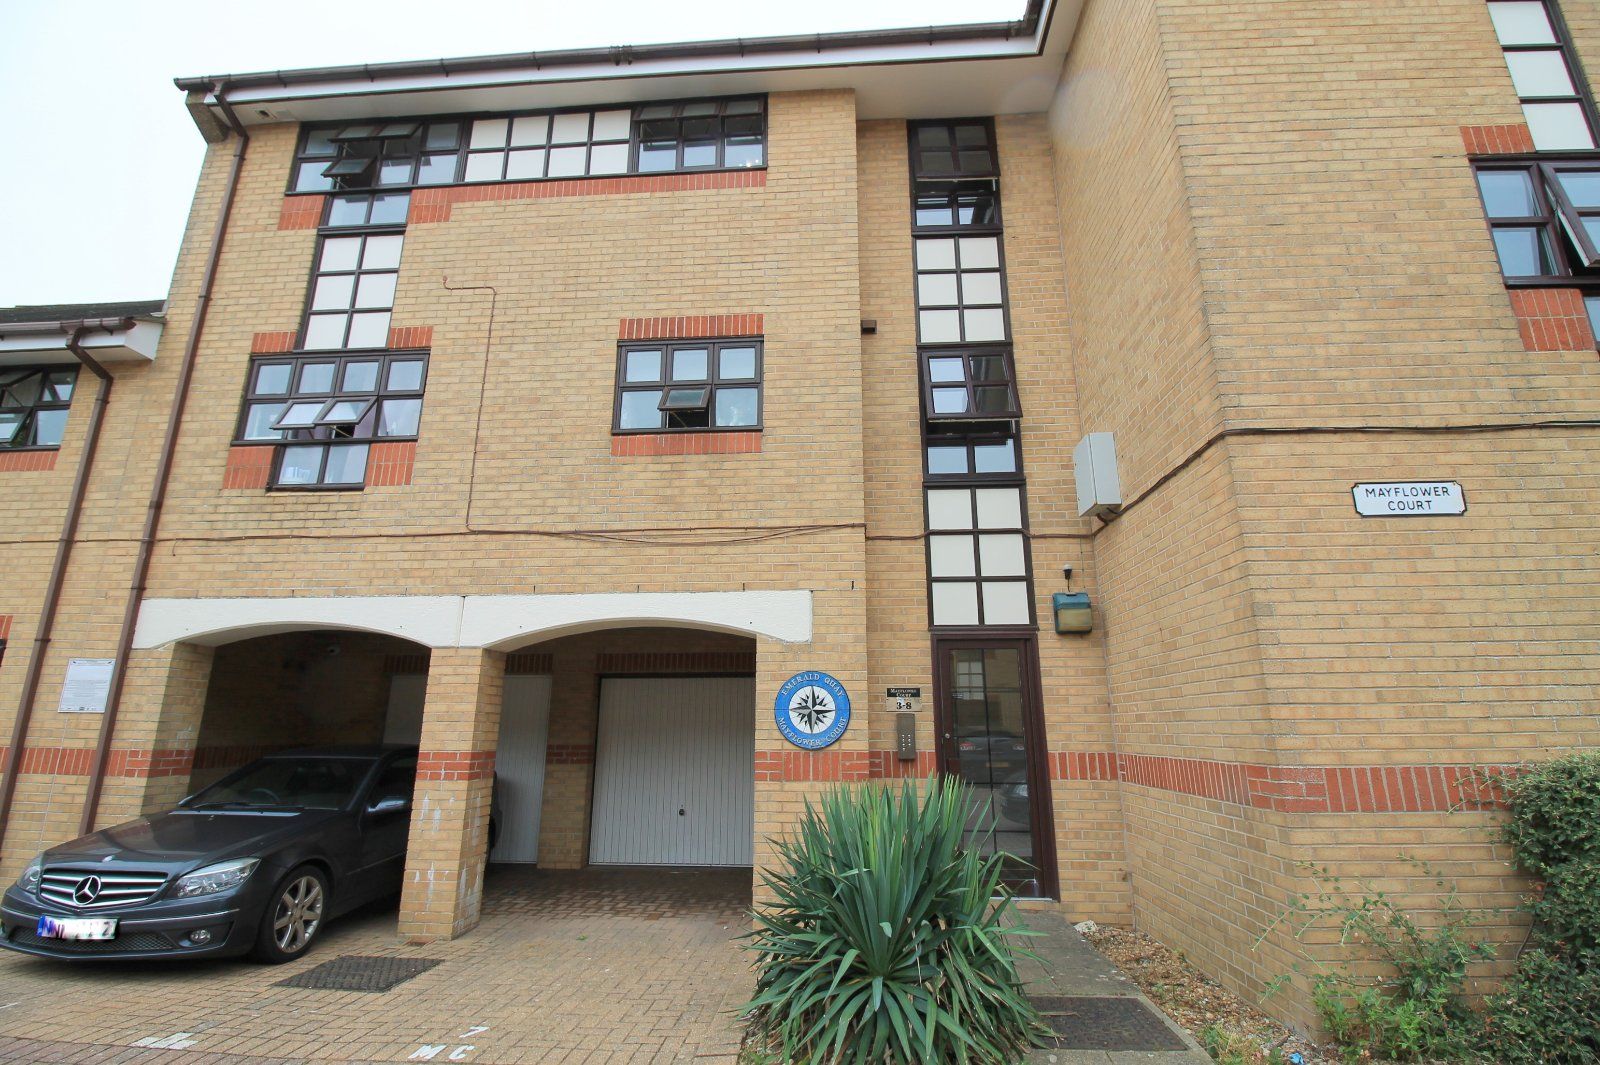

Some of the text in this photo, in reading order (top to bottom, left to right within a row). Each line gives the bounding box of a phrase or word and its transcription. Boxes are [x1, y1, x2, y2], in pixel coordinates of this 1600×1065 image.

[1365, 486, 1450, 498] MAYFLOWER
[1387, 500, 1432, 511] COURT
[781, 673, 845, 699] EMERALD QUAY
[896, 702, 912, 710] 3-8
[778, 716, 847, 746] MAYFLOWER COURT
